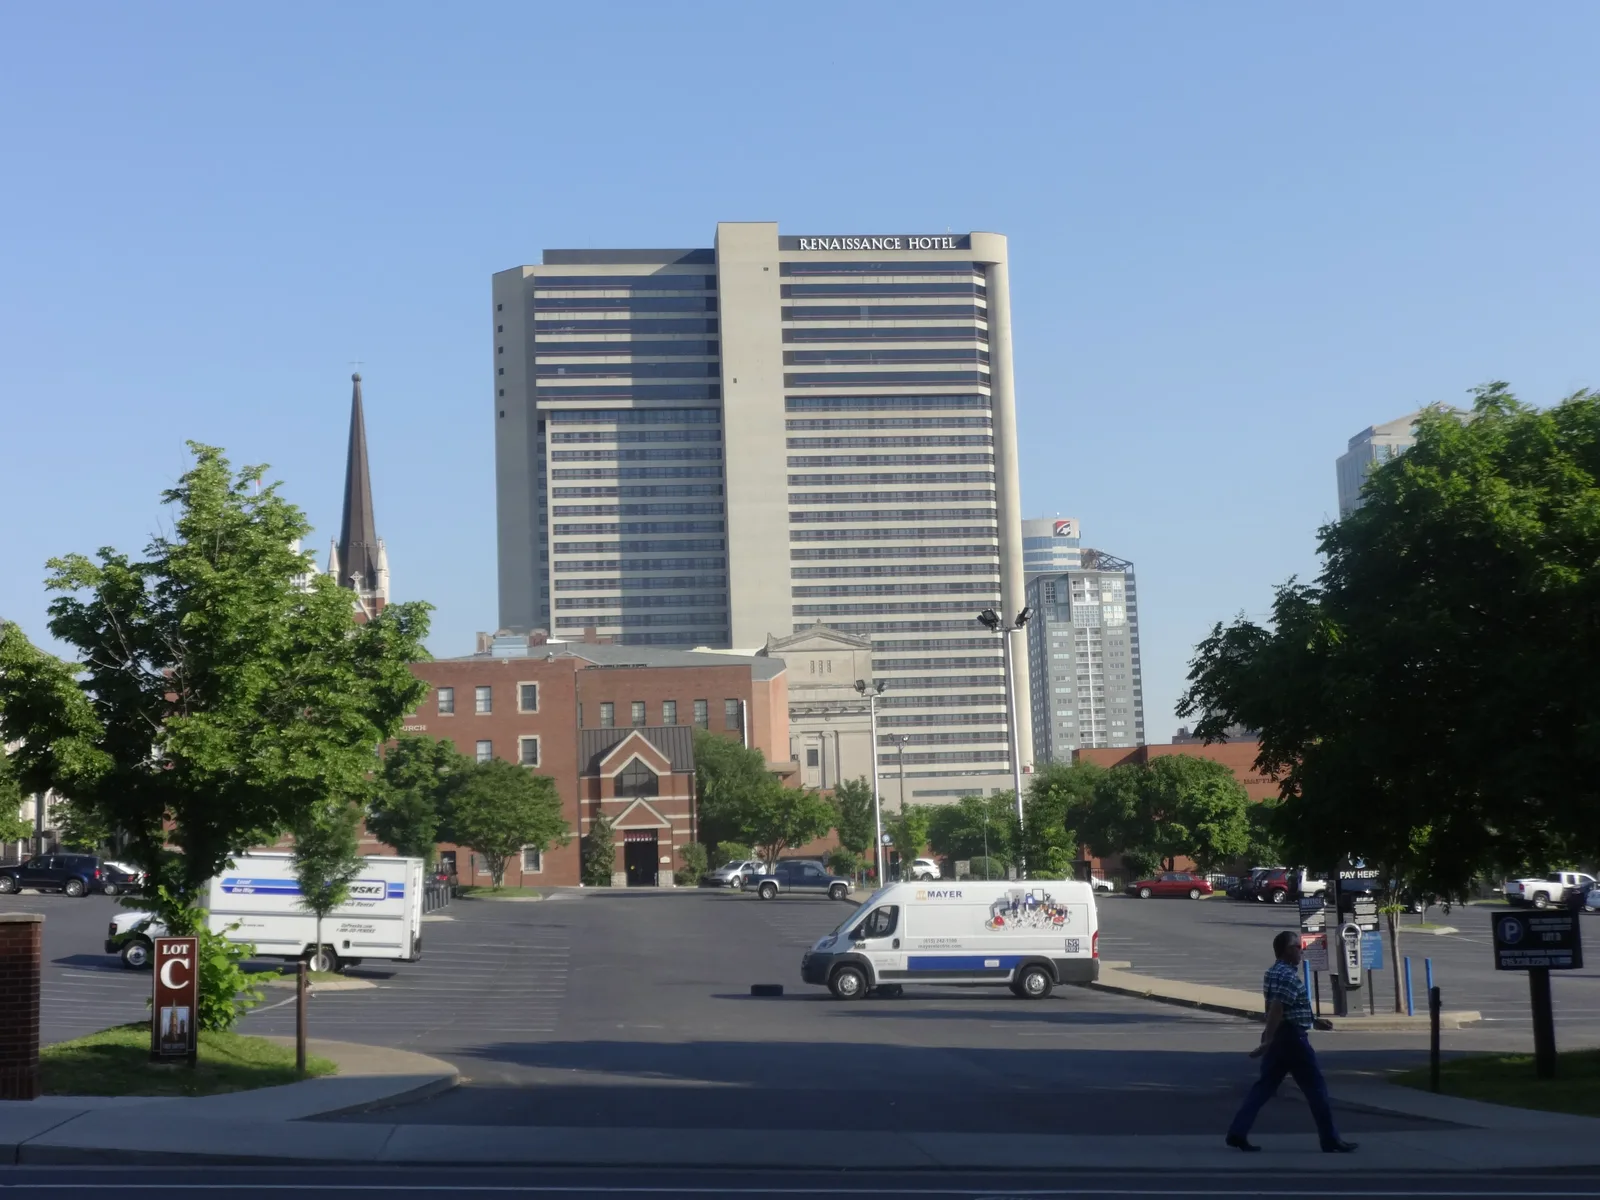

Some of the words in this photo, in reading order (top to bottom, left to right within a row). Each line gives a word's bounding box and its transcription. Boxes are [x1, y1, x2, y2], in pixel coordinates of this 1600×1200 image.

[799, 238, 901, 250] RENAISSANCE
[908, 237, 957, 249] HOTEL
[1339, 871, 1356, 880] PAY
[348, 885, 382, 895] NSKE
[927, 890, 963, 899] MAYER
[162, 943, 190, 955] LOT
[160, 958, 190, 990] C
